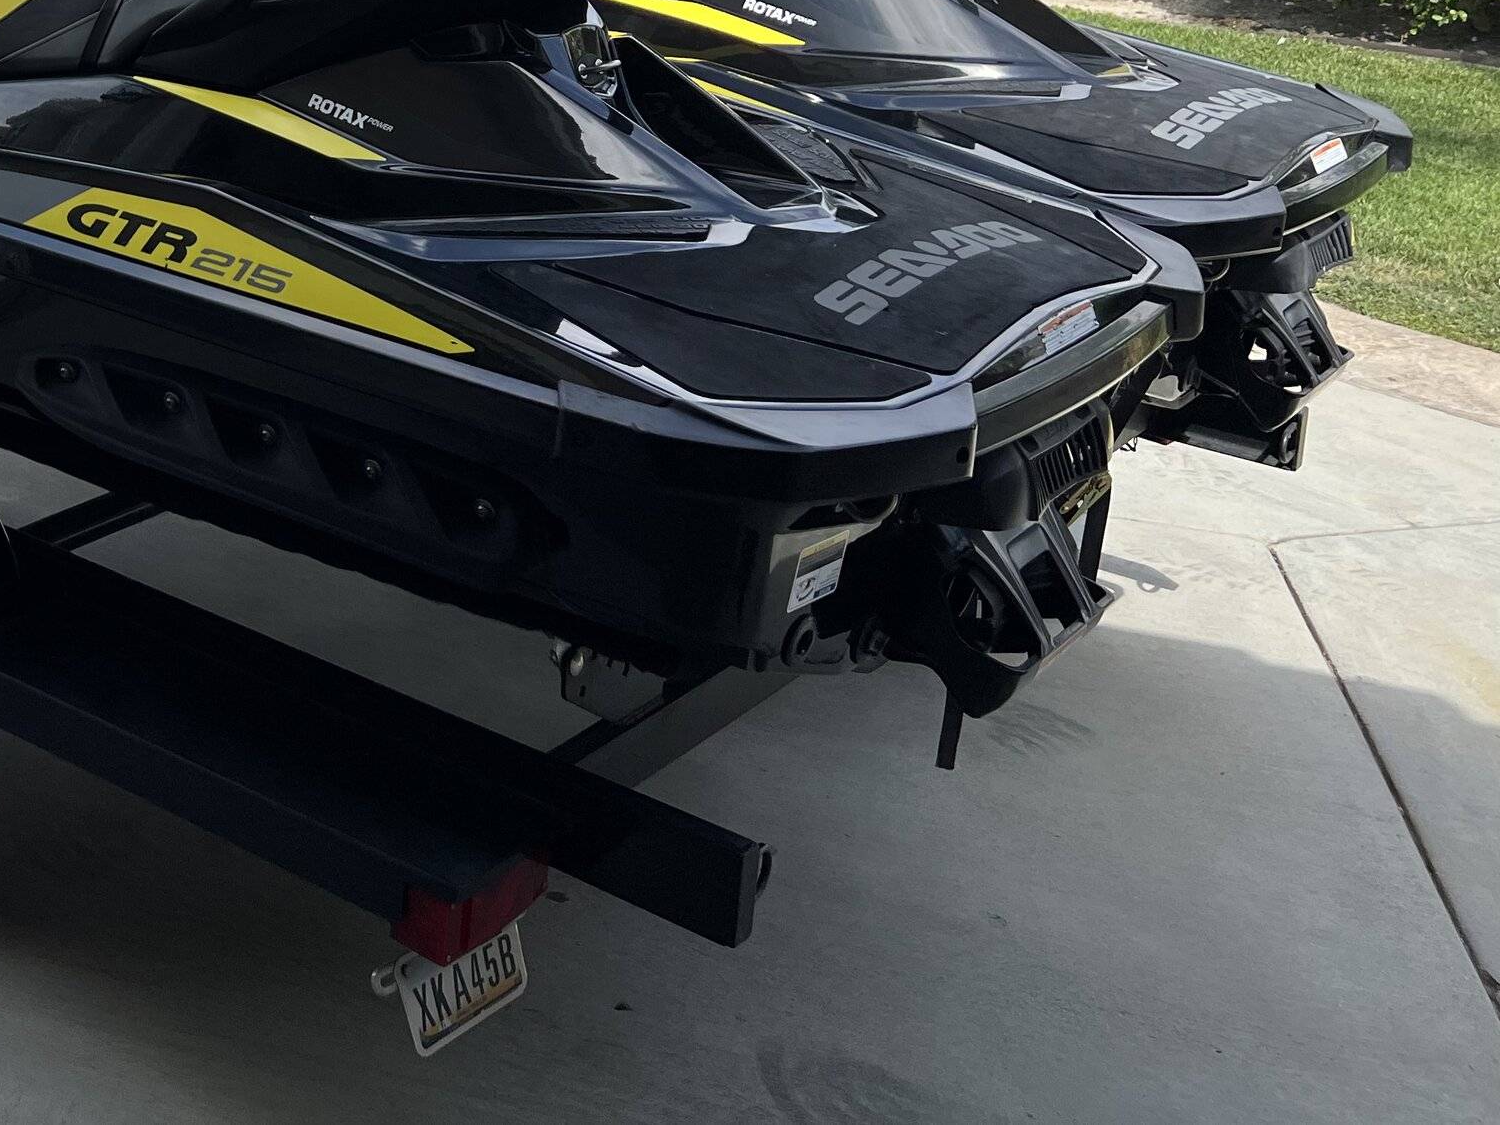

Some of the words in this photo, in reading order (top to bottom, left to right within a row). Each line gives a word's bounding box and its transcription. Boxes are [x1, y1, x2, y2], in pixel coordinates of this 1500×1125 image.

[307, 93, 369, 129] ROTAX
[366, 117, 394, 132] POWER
[66, 203, 198, 264] GTR
[190, 248, 293, 294] 215
[412, 933, 517, 1032] XKA45B
